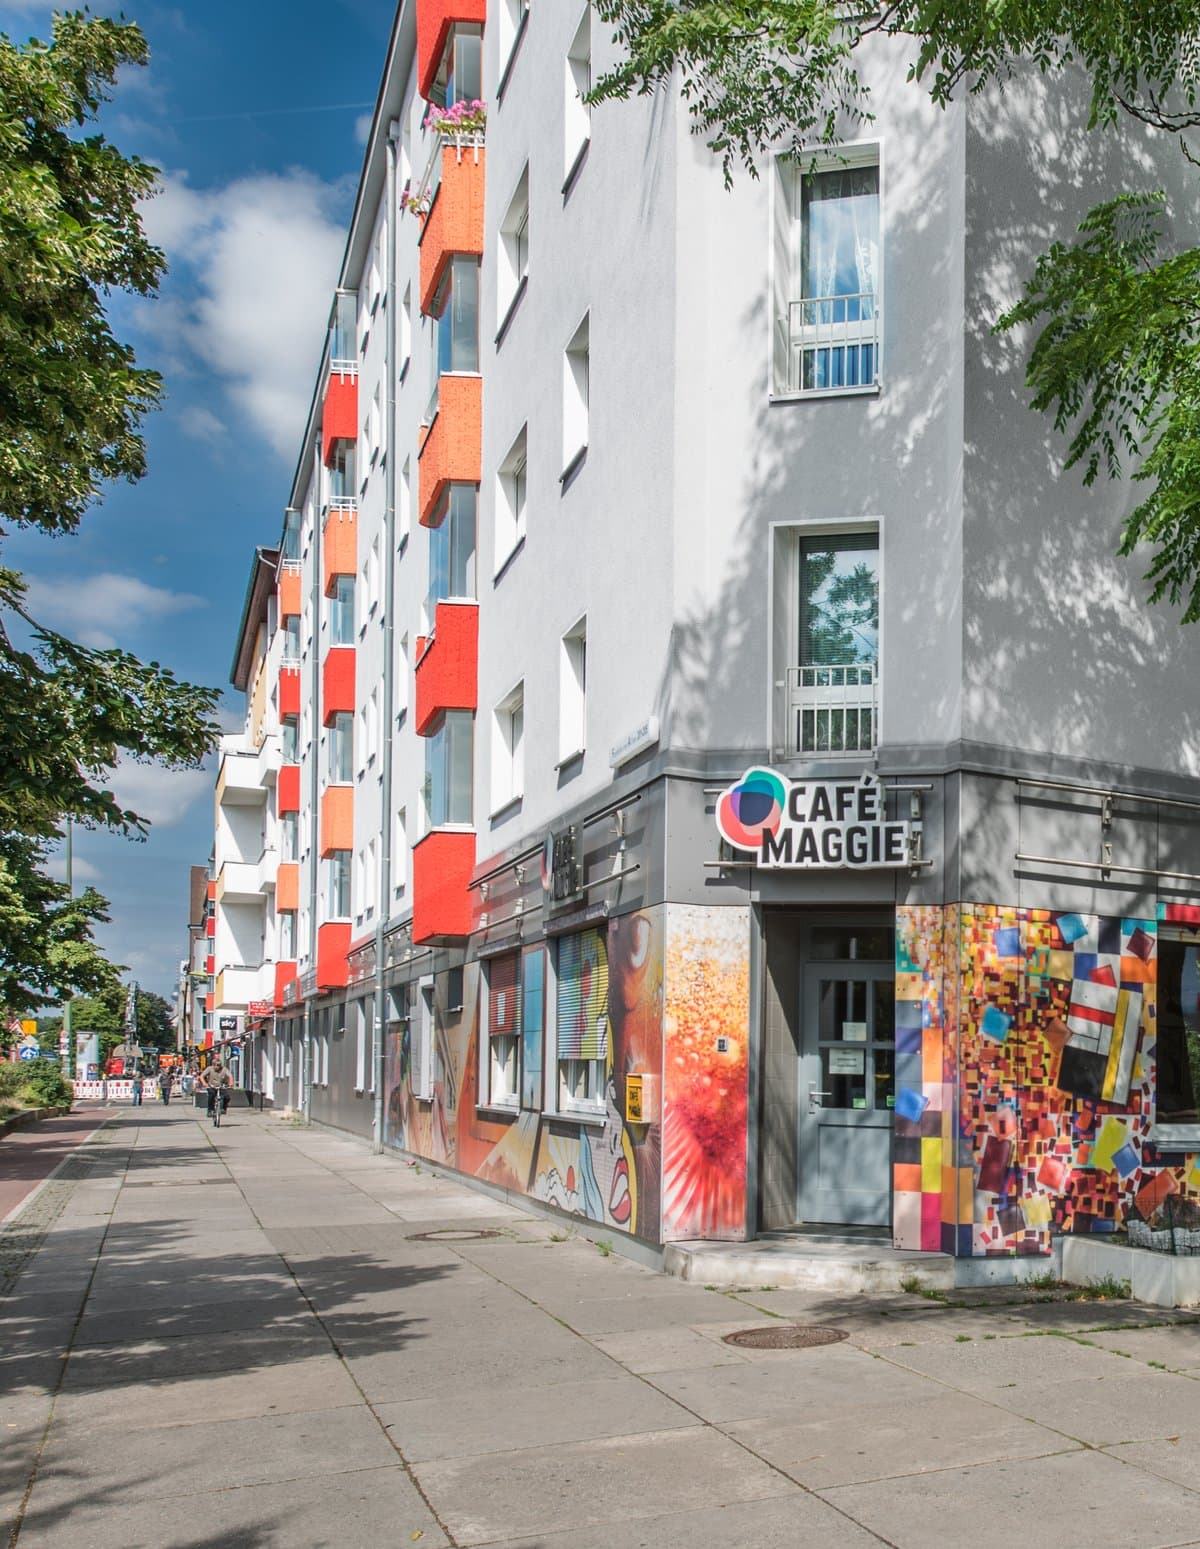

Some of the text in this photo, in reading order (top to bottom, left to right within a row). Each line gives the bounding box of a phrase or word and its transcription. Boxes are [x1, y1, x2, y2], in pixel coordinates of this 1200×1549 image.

[789, 776, 877, 822] CAFÉ
[762, 826, 904, 864] MAGGIE
[221, 1020, 236, 1028] sky
